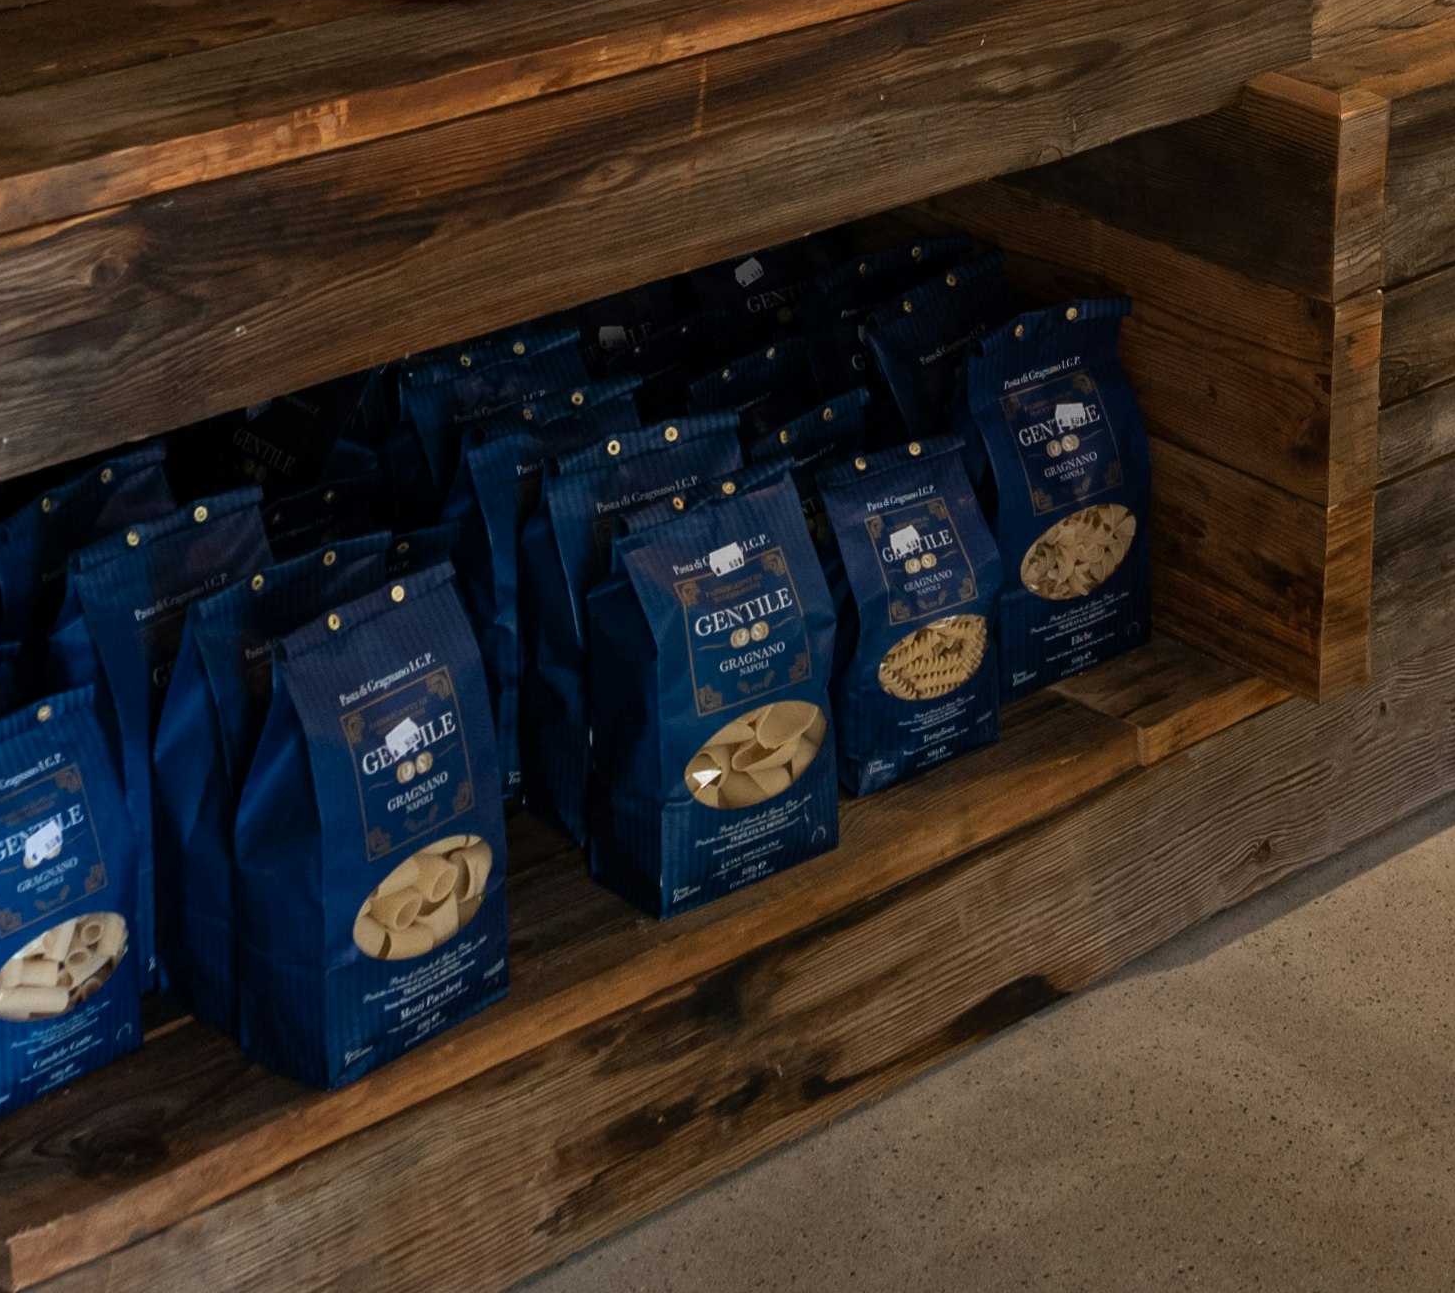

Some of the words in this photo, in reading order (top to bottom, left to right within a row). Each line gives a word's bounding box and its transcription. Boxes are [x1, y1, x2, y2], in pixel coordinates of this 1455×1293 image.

[1019, 405, 1101, 448] GENTLE
[1044, 451, 1099, 479] GRAGNANO
[695, 588, 794, 638] GENTILE
[719, 641, 786, 674] GRAGNANO
[739, 660, 770, 678] NAPOLI
[339, 690, 359, 707] Pasta
[368, 665, 411, 693] Gragnano
[362, 711, 457, 776] GEILE
[386, 771, 449, 812] GRAGNANO
[406, 792, 435, 814] NAPOLI
